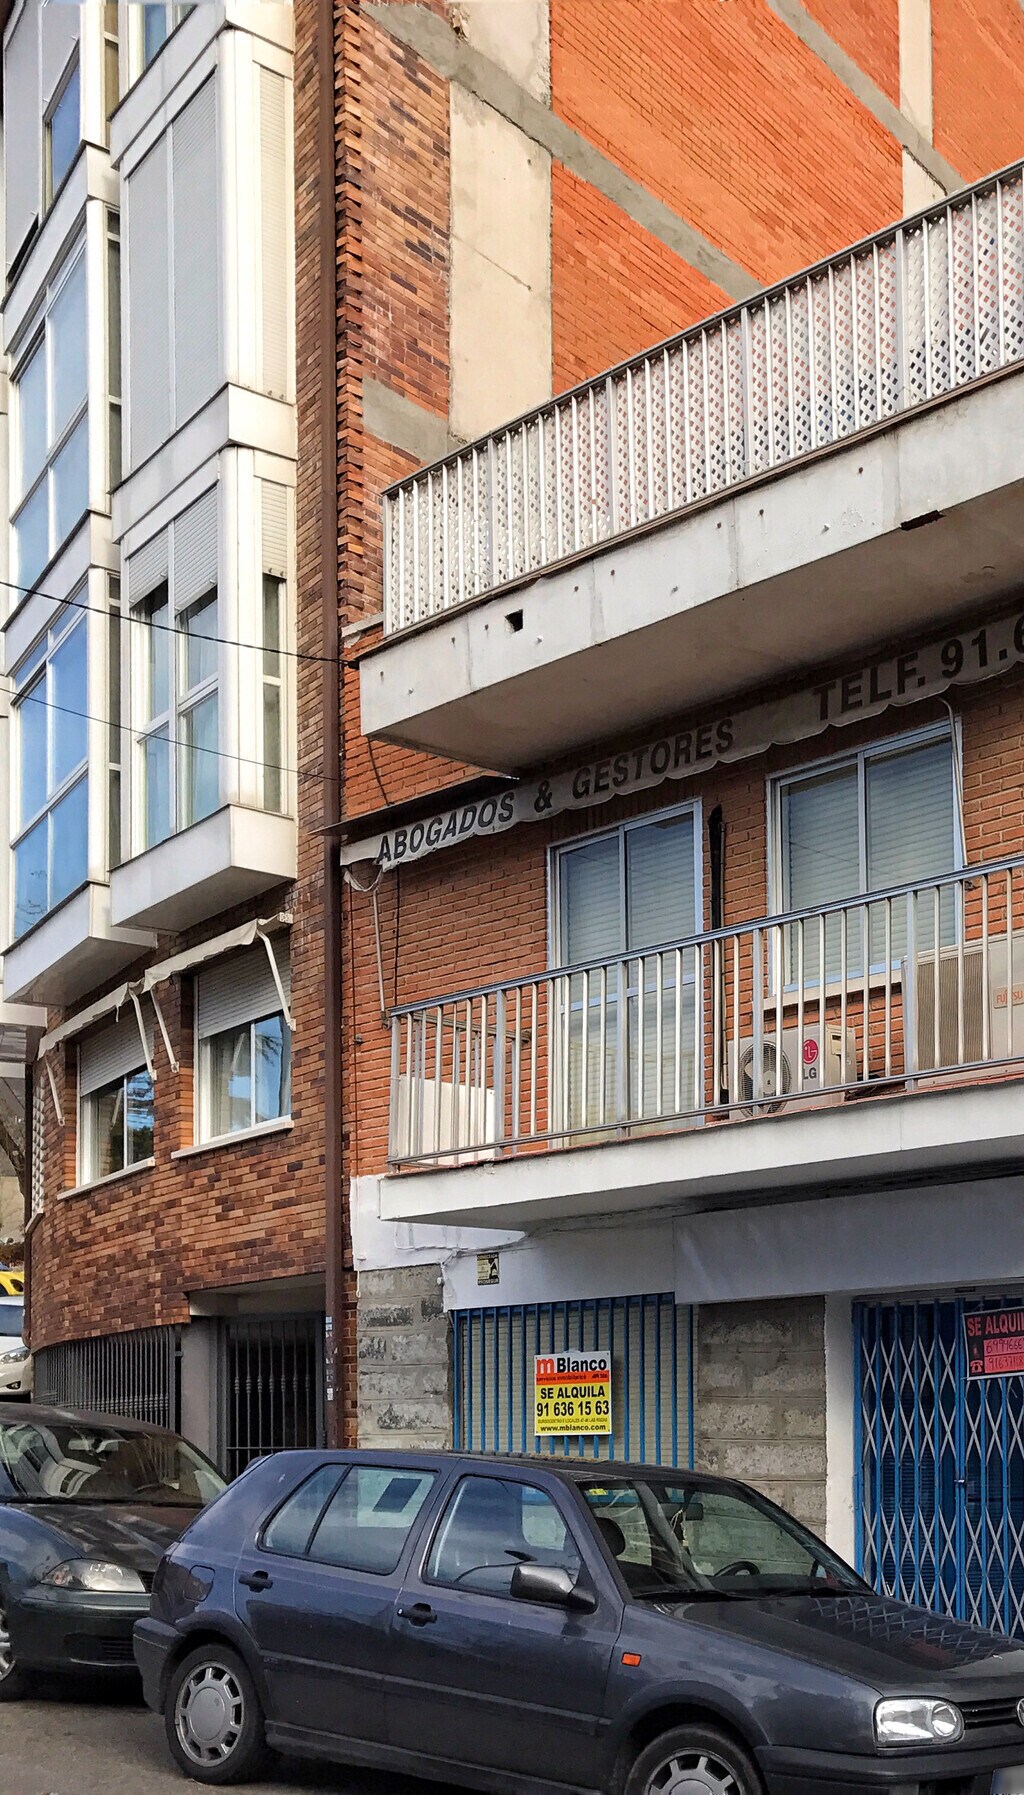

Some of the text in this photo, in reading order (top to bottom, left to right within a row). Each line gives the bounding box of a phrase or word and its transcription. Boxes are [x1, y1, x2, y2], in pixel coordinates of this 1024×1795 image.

[376, 791, 515, 864] ABOGADOS
[533, 779, 553, 813] &
[571, 717, 735, 800] GESTORES
[811, 651, 926, 721] TELF.
[802, 1067, 817, 1080] LG
[967, 1316, 982, 1337] SE
[540, 1385, 605, 1399] SE ALQUILA
[536, 1400, 610, 1417] 91 636 15 63
[540, 1424, 606, 1432] www.mblanco.com
